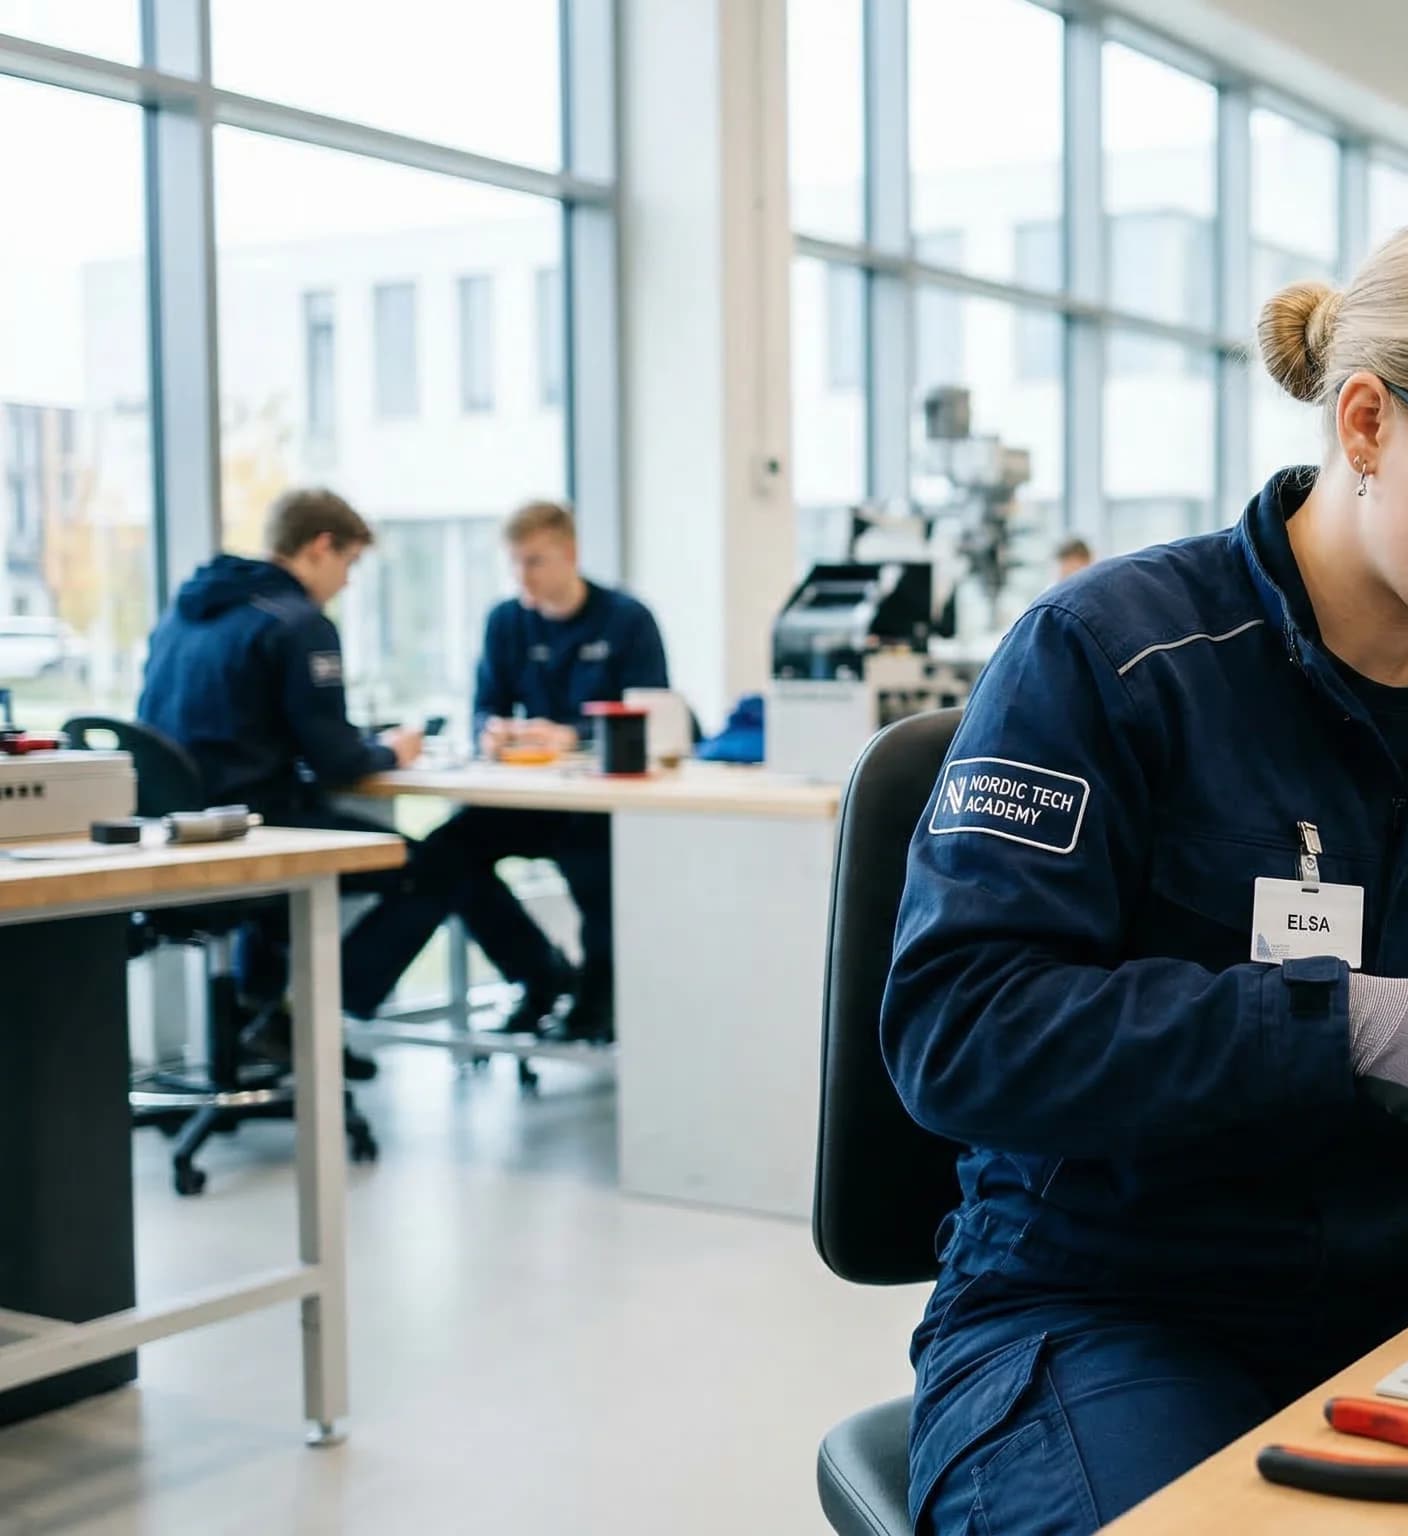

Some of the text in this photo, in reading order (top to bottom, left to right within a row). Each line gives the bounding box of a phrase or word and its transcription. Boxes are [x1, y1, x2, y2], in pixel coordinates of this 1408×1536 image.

[969, 775, 1074, 813] NORDIC TECH
[964, 796, 1042, 826] ACADEMY
[1288, 914, 1330, 932] ELSA
